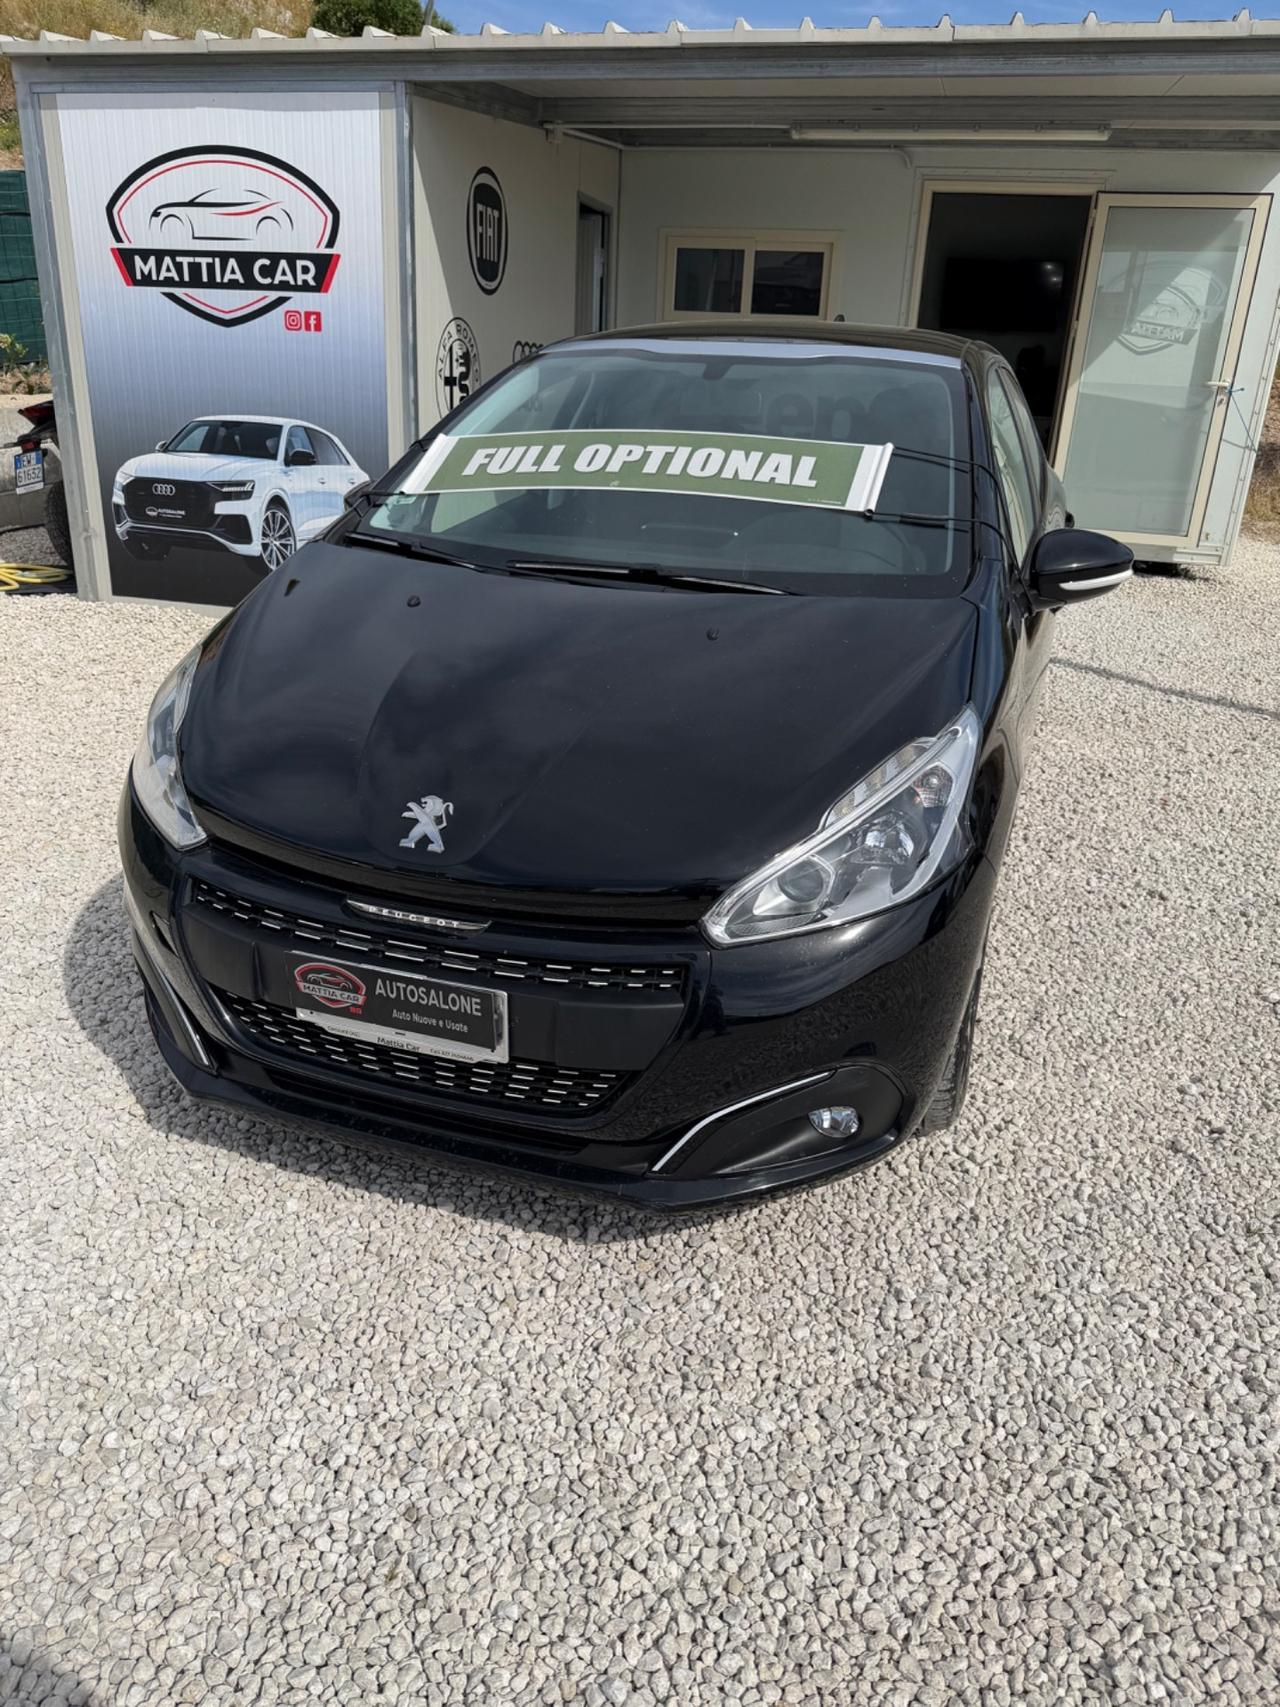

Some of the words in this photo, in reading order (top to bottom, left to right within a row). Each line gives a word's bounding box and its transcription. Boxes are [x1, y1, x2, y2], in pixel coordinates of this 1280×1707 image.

[476, 202, 500, 262] FIAT
[133, 255, 245, 284] MATTIA
[253, 258, 317, 286] CAR
[438, 330, 453, 380] ALFA
[455, 321, 479, 383] ROMEO
[461, 444, 567, 476] FULL
[573, 443, 818, 488] OPTIONAL
[368, 905, 460, 928] PEUGEOT
[303, 984, 338, 999] MATTIA
[340, 992, 360, 1003] CAR
[375, 978, 482, 1017] AUTOSALONE
[392, 1008, 411, 1021] Auto
[412, 1012, 437, 1027] Nuove
[438, 1019, 444, 1029] e
[445, 1017, 469, 1033] Usate
[376, 1036, 404, 1049] Mattia
[406, 1043, 421, 1053] Car
